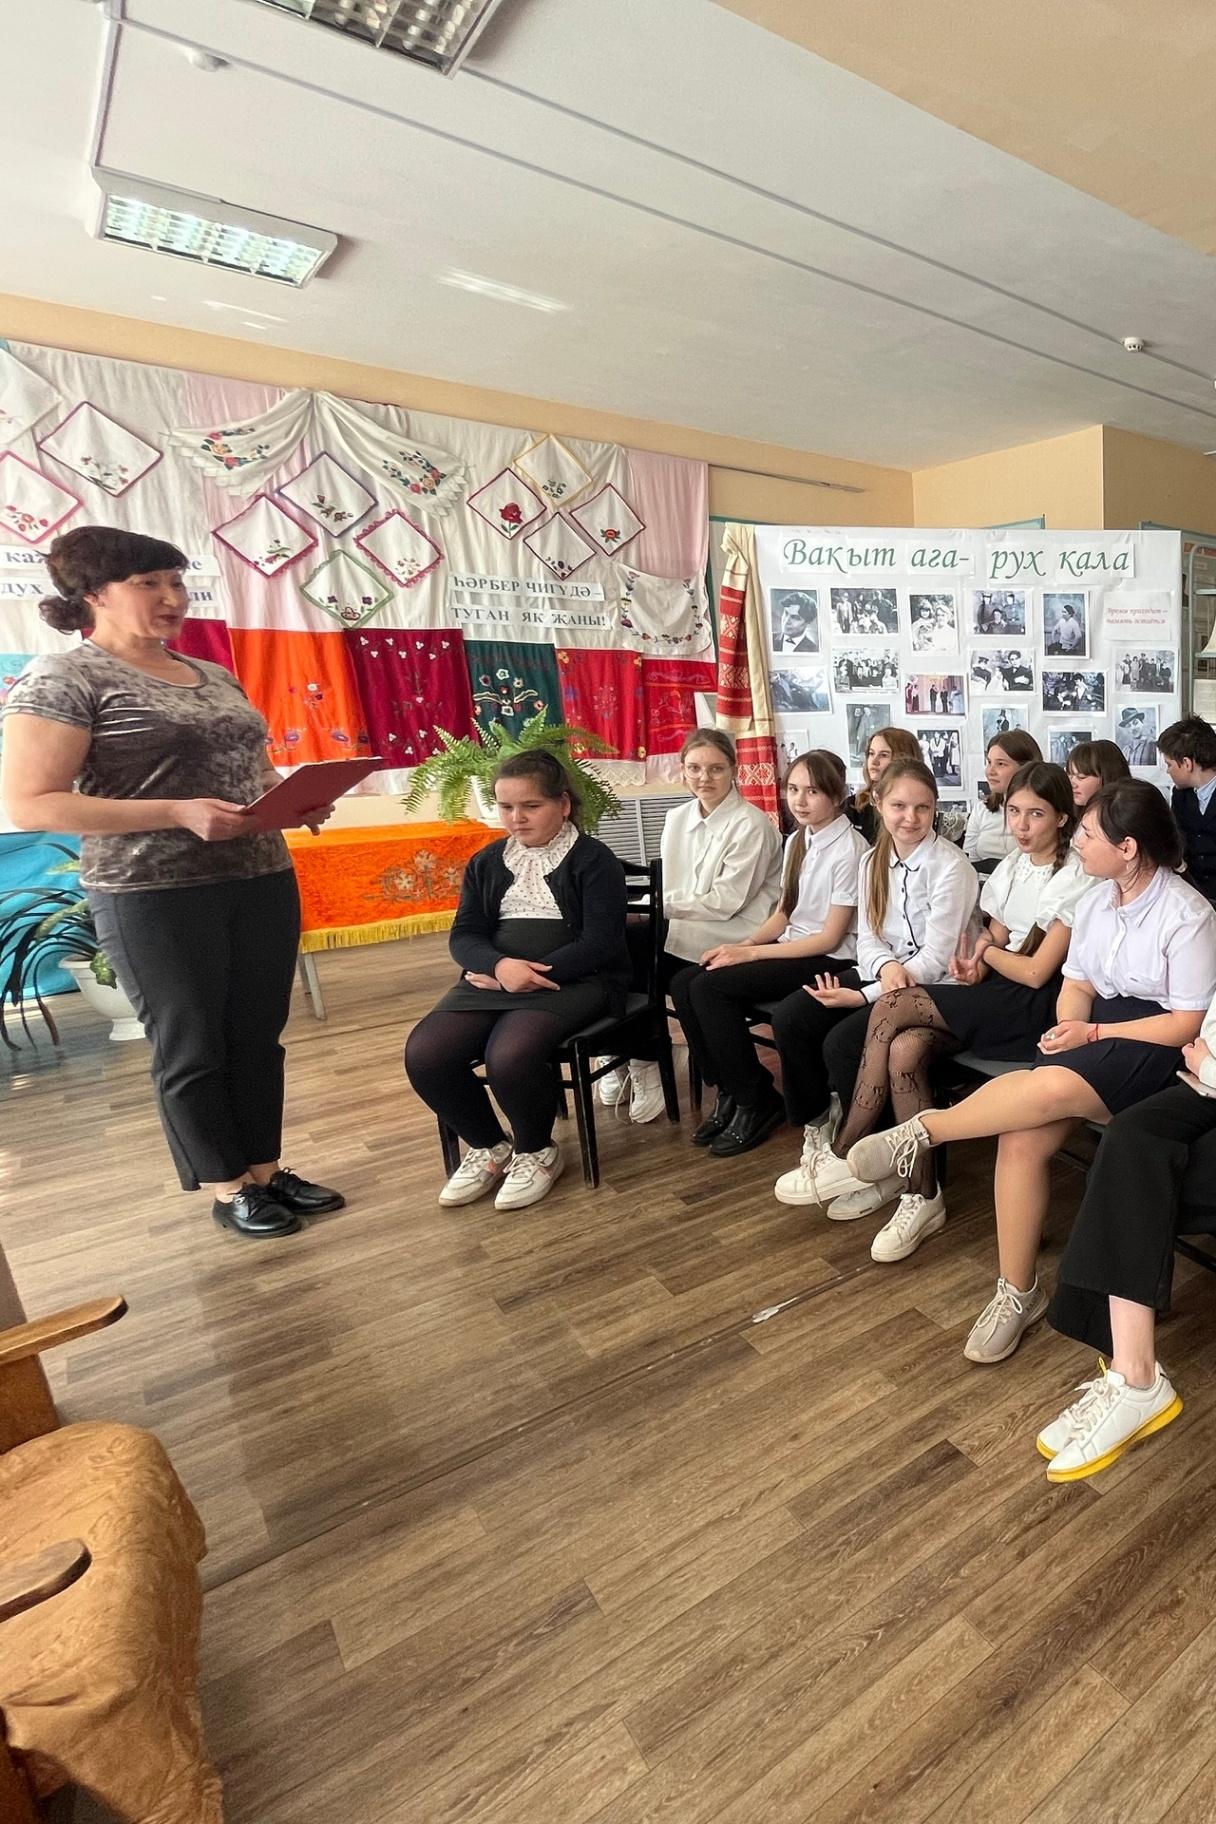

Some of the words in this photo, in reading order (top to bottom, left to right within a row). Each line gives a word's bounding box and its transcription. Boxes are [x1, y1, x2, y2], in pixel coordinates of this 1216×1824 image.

[783, 538, 897, 574] Вакыт
[988, 546, 1047, 580] рух
[1058, 546, 1131, 577] кала
[1, 582, 44, 597] дух
[451, 607, 510, 622] ТУГАН
[521, 612, 544, 623] ЯК
